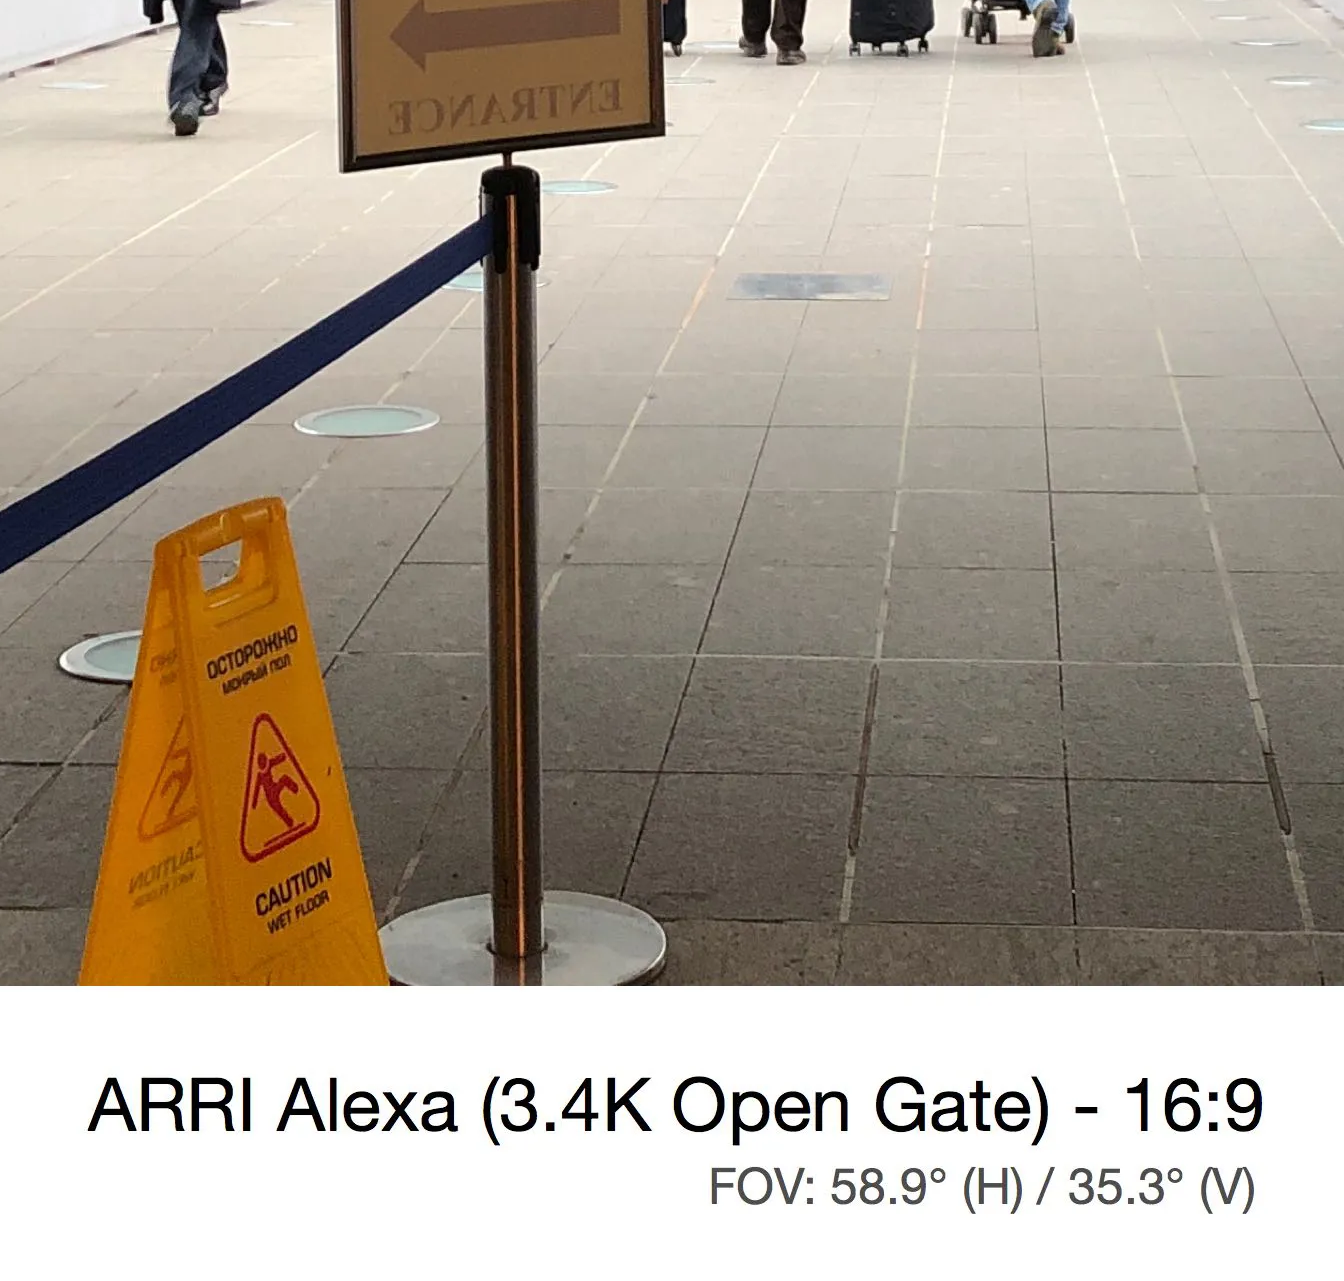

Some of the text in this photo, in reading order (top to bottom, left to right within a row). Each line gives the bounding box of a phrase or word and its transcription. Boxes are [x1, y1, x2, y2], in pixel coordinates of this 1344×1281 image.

[207, 624, 298, 679] ОСТОРОЖНО
[255, 856, 332, 916] CAUTION
[267, 889, 330, 934] WET FLOOR
